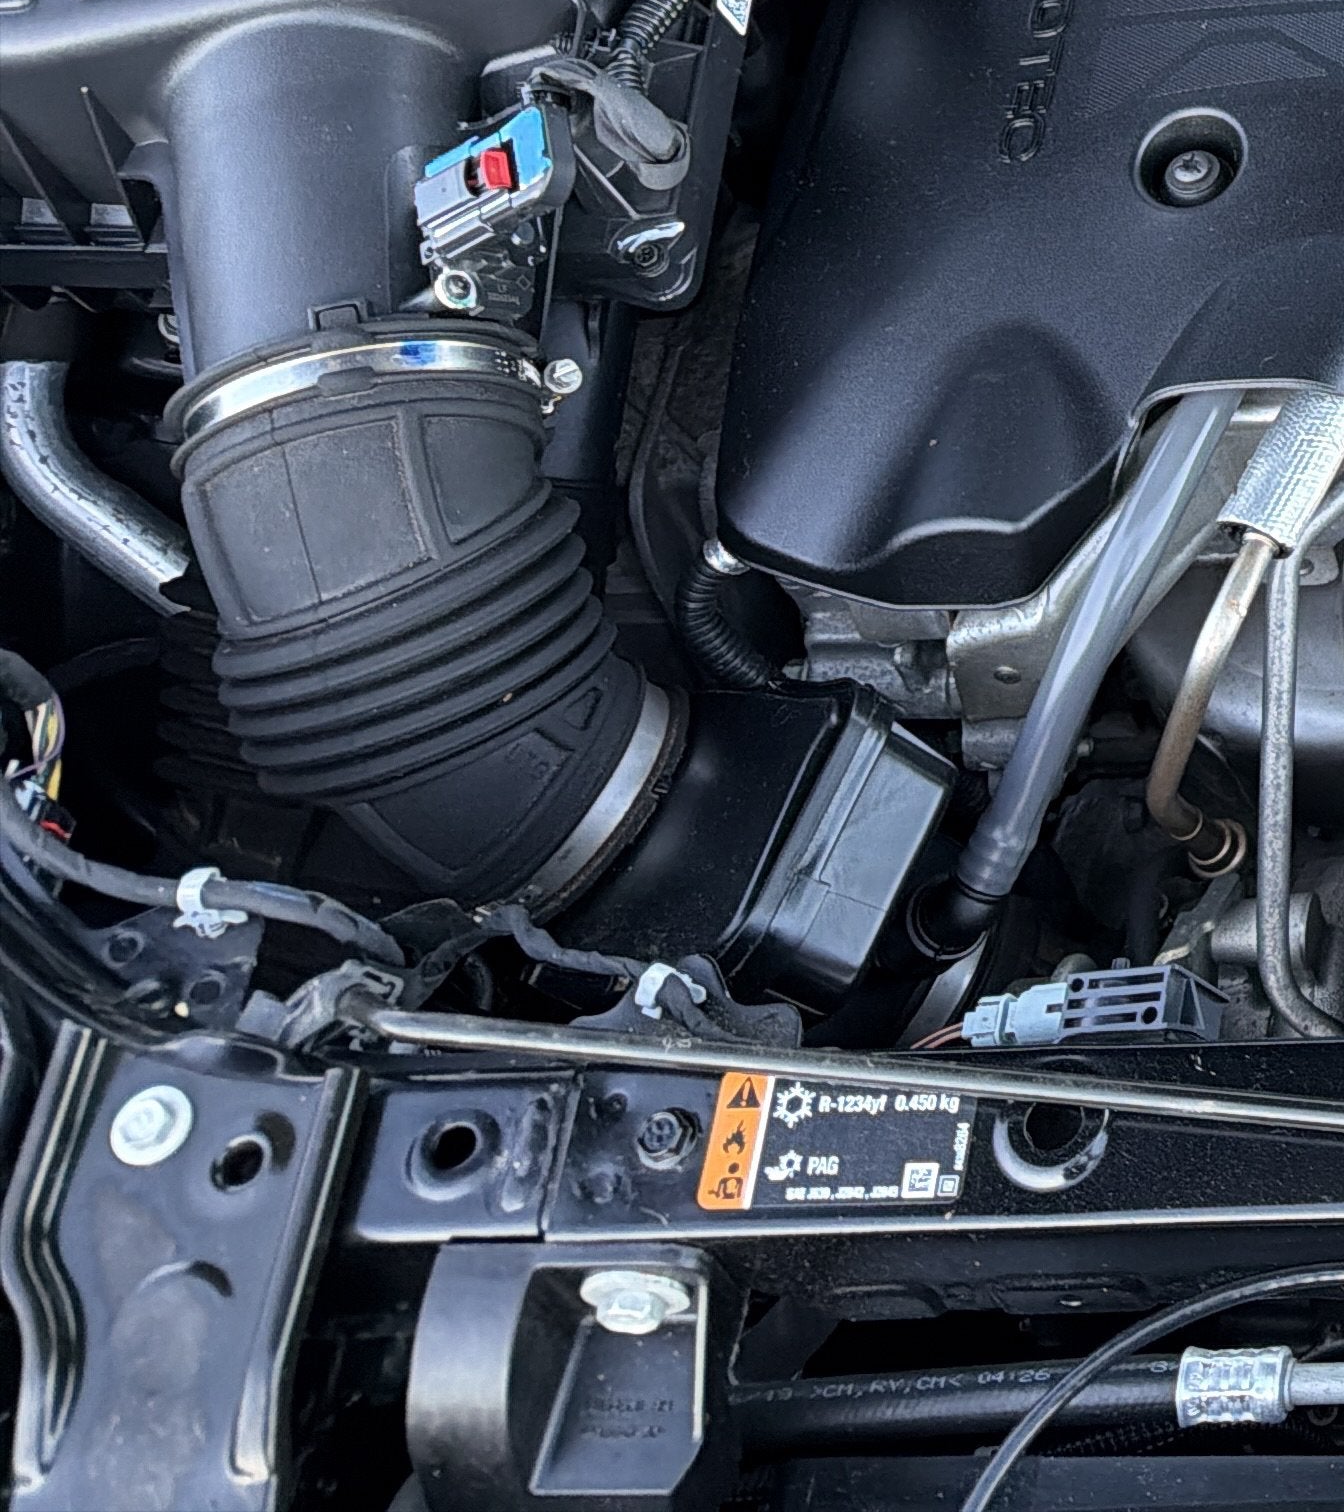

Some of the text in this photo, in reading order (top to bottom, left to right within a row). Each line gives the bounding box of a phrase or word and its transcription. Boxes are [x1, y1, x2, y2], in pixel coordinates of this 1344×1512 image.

[818, 1094, 961, 1116] R-1234yf 0.450 kg
[806, 1155, 840, 1176] PAG
